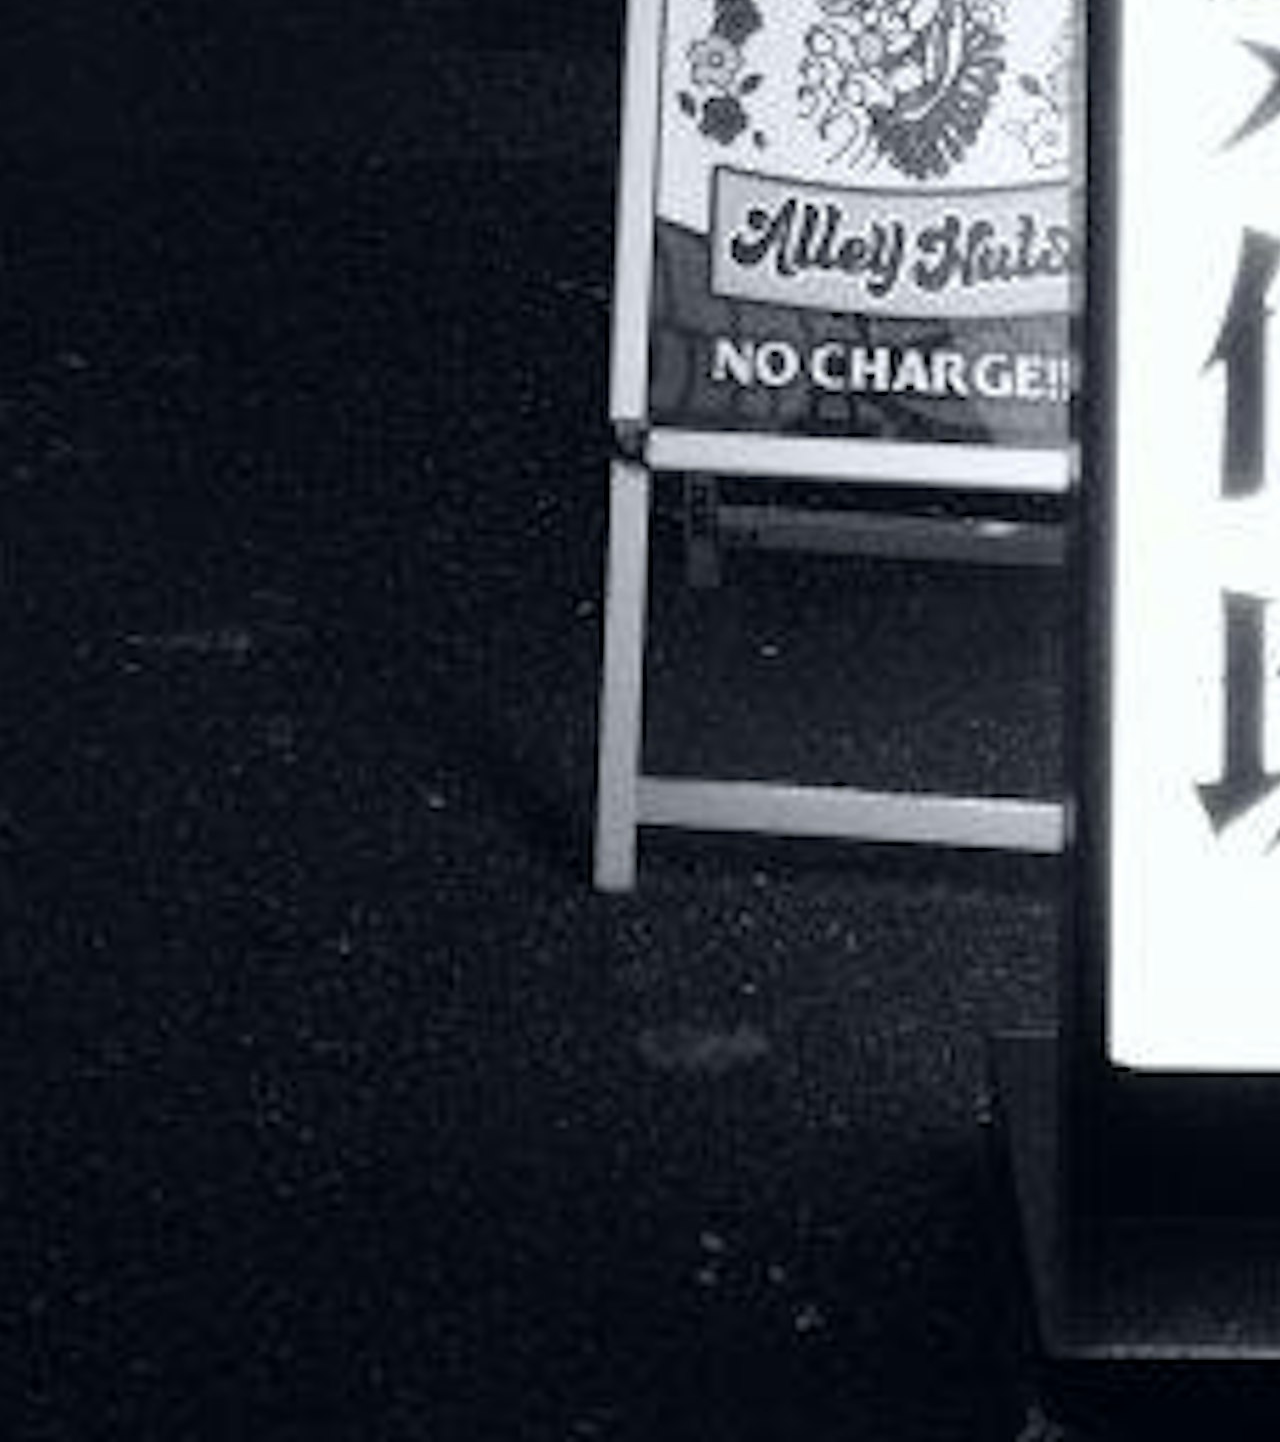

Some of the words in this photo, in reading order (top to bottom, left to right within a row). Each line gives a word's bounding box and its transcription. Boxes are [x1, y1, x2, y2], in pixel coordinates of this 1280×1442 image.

[731, 197, 905, 298] Alley
[715, 337, 800, 388] NO
[810, 341, 1071, 403] CHARGE!!
